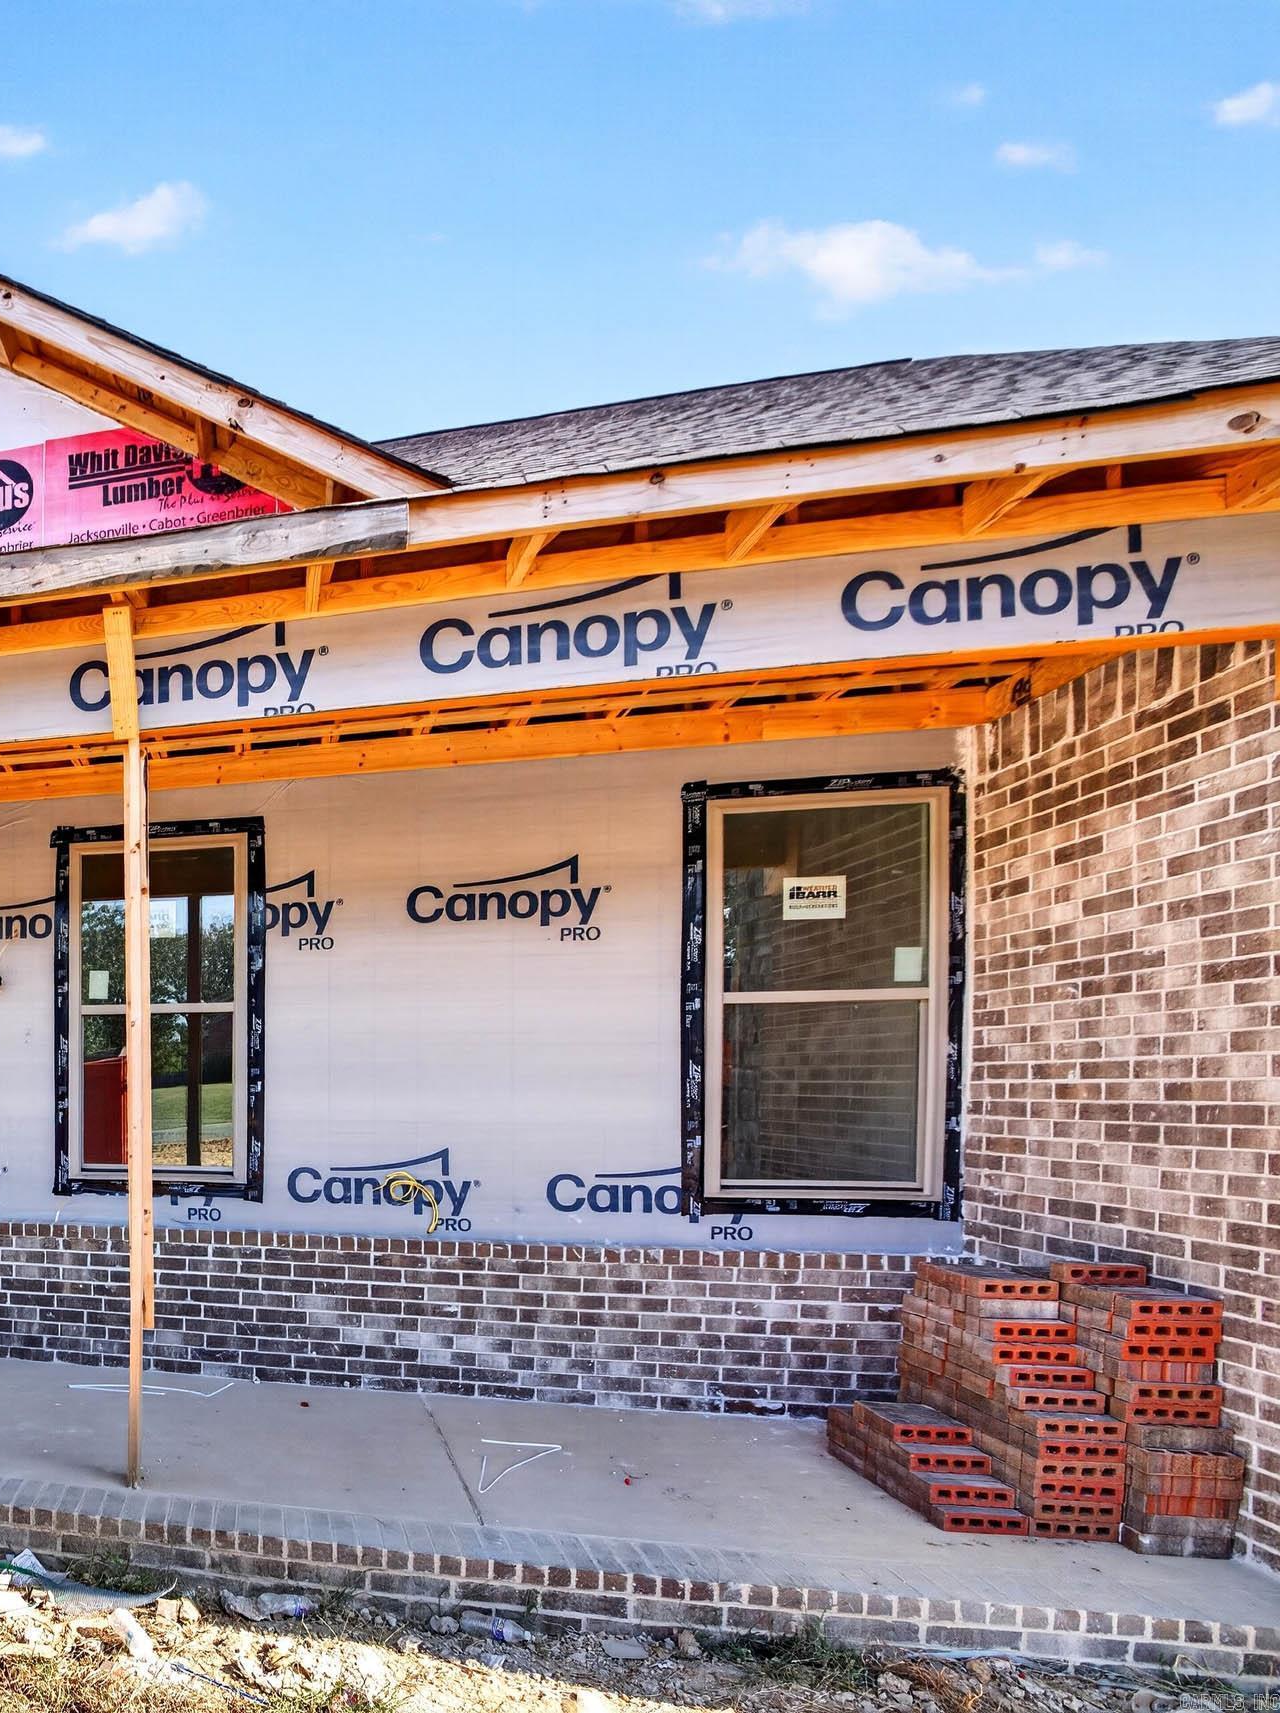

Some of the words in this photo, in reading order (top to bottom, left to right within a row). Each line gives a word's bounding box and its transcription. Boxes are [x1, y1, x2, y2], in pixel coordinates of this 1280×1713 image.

[68, 448, 120, 476] Whit
[102, 473, 185, 506] Lumber
[159, 495, 176, 513] The
[180, 493, 204, 510] Plus
[68, 522, 140, 544] Jacksonville
[148, 515, 187, 532] Cabot
[196, 504, 266, 525] Greenbrier
[841, 557, 1182, 632] Canopy
[419, 602, 717, 675] Canopy
[406, 885, 602, 927] Canopy
[298, 936, 335, 951] PRO
[560, 926, 601, 941] PRO
[546, 1173, 699, 1223] Cano
[187, 1207, 221, 1222] PRO
[710, 1225, 753, 1241] PRO
